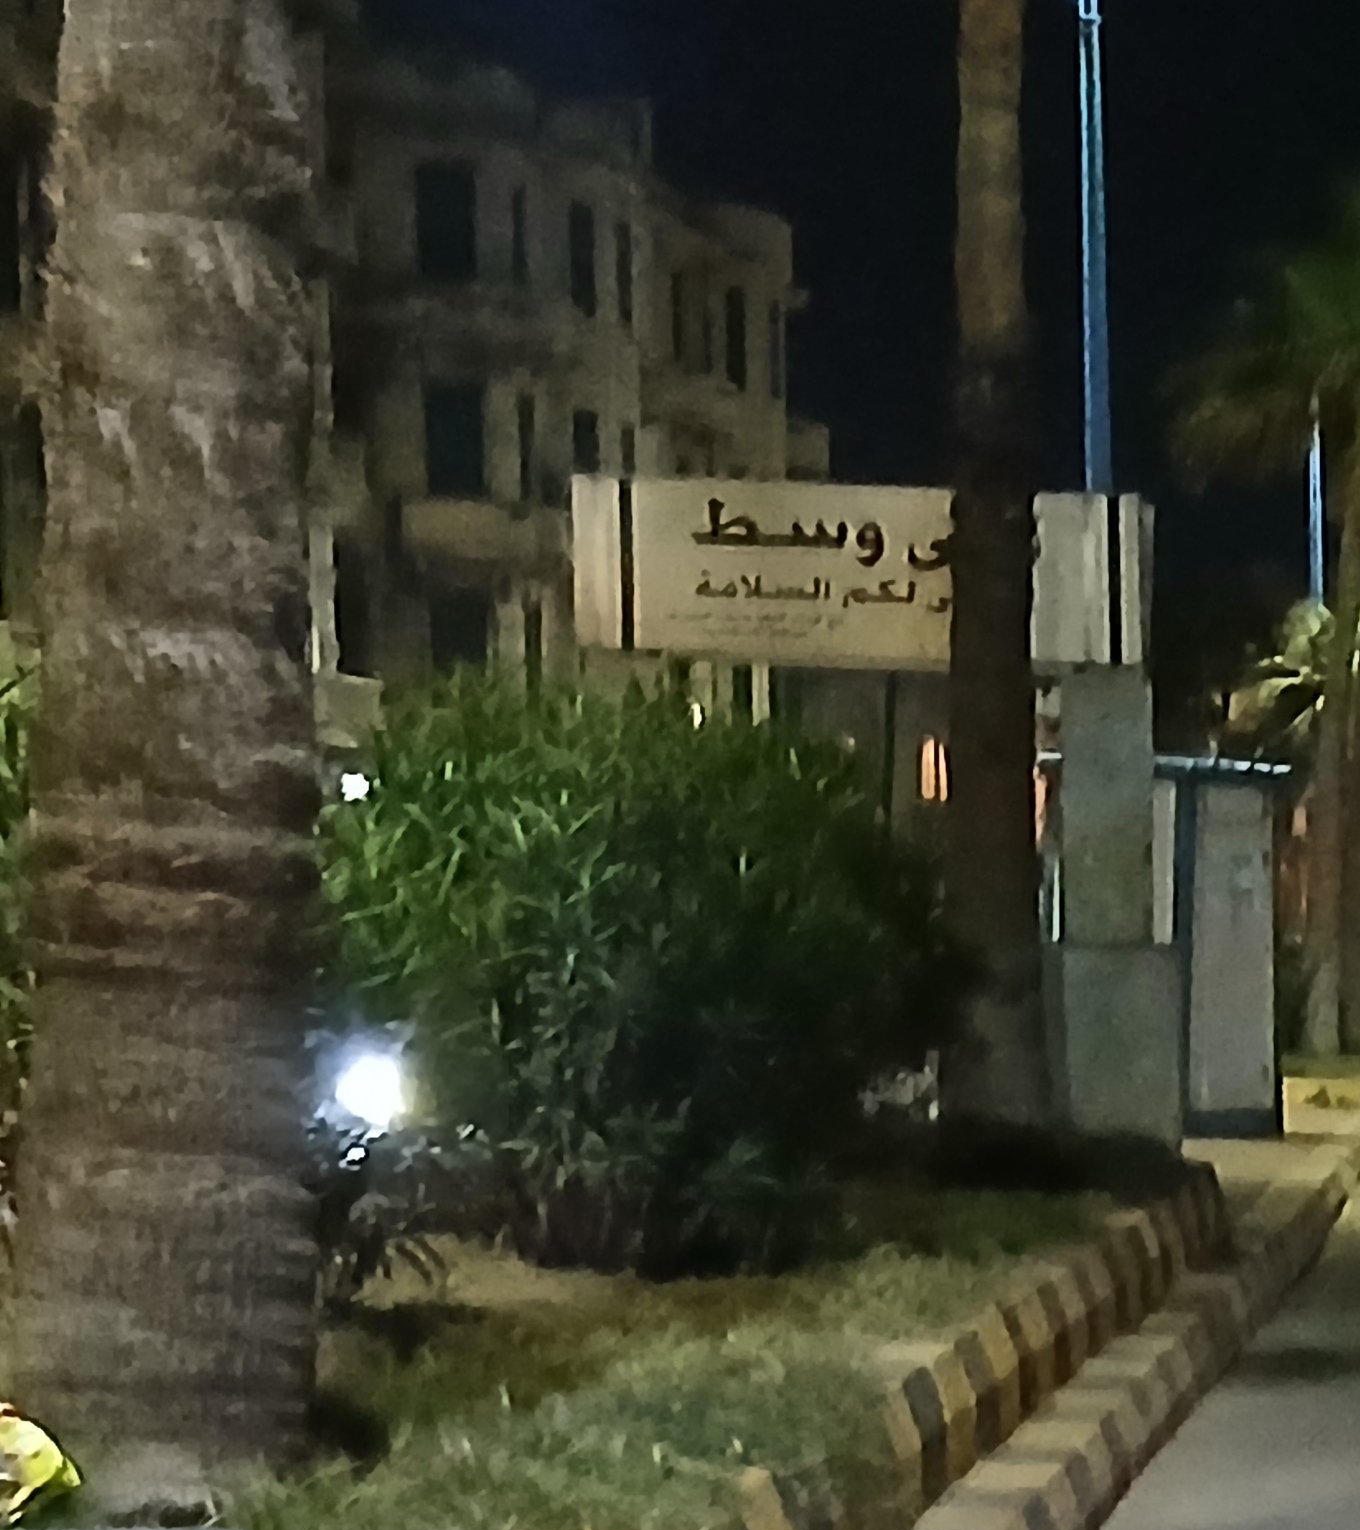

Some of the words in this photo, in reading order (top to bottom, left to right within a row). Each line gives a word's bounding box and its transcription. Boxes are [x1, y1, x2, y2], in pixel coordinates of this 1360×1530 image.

[691, 498, 885, 567] وسط
[694, 568, 831, 601] السلامة
[841, 579, 916, 609] لكم
